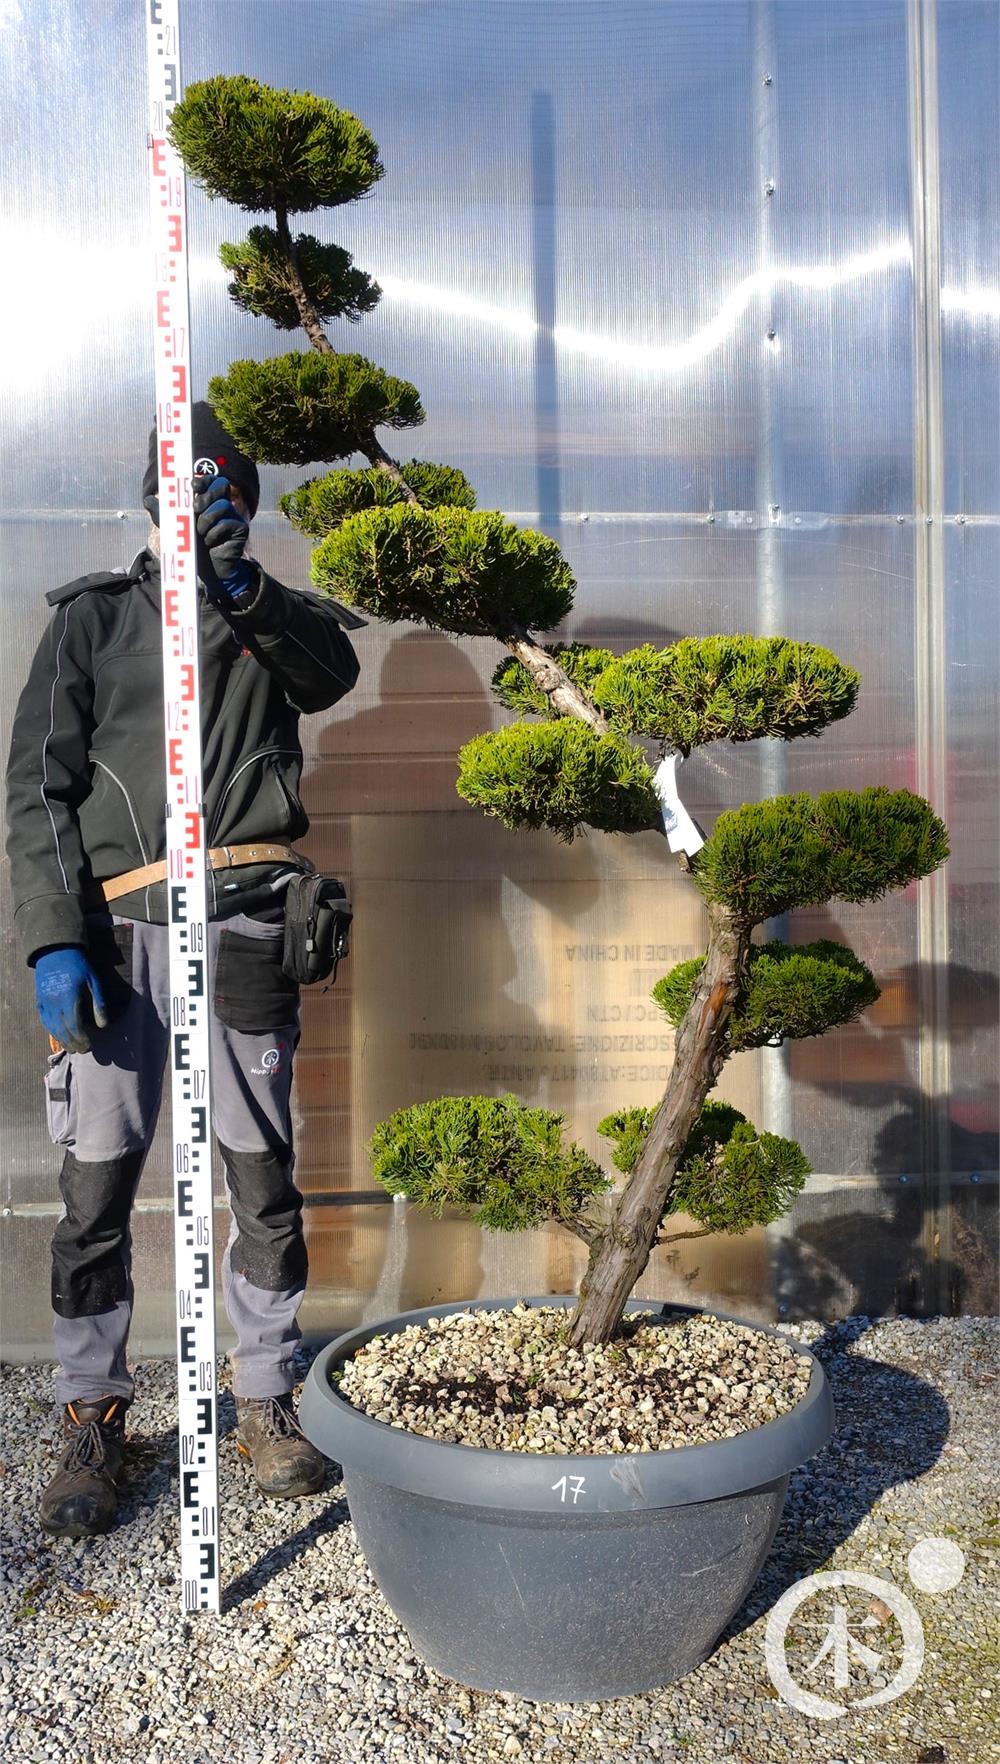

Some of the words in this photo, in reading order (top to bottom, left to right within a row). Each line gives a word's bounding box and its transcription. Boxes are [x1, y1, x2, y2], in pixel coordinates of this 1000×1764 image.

[165, 25, 177, 56] 21
[153, 101, 164, 131] 20
[168, 176, 182, 208] 19
[172, 328, 185, 358] 17
[158, 402, 172, 433] 16
[177, 477, 190, 508] 15
[163, 552, 176, 582] 14
[181, 626, 194, 657] 13
[167, 701, 180, 731] 12
[185, 775, 198, 804] 11
[170, 848, 183, 879] 10
[190, 922, 203, 953] 09
[565, 944, 619, 962] CHINA
[624, 944, 640, 962] IN
[646, 944, 695, 962] MADE
[173, 996, 185, 1026] 08
[193, 1069, 206, 1100] 07
[176, 1143, 189, 1174] 06
[196, 1215, 209, 1246] 05
[179, 1289, 192, 1320] 04
[199, 1361, 212, 1391] 03
[181, 1434, 195, 1465] 02
[551, 1475, 587, 1504] 17
[202, 1506, 215, 1536] 01
[185, 1579, 198, 1610] 00
